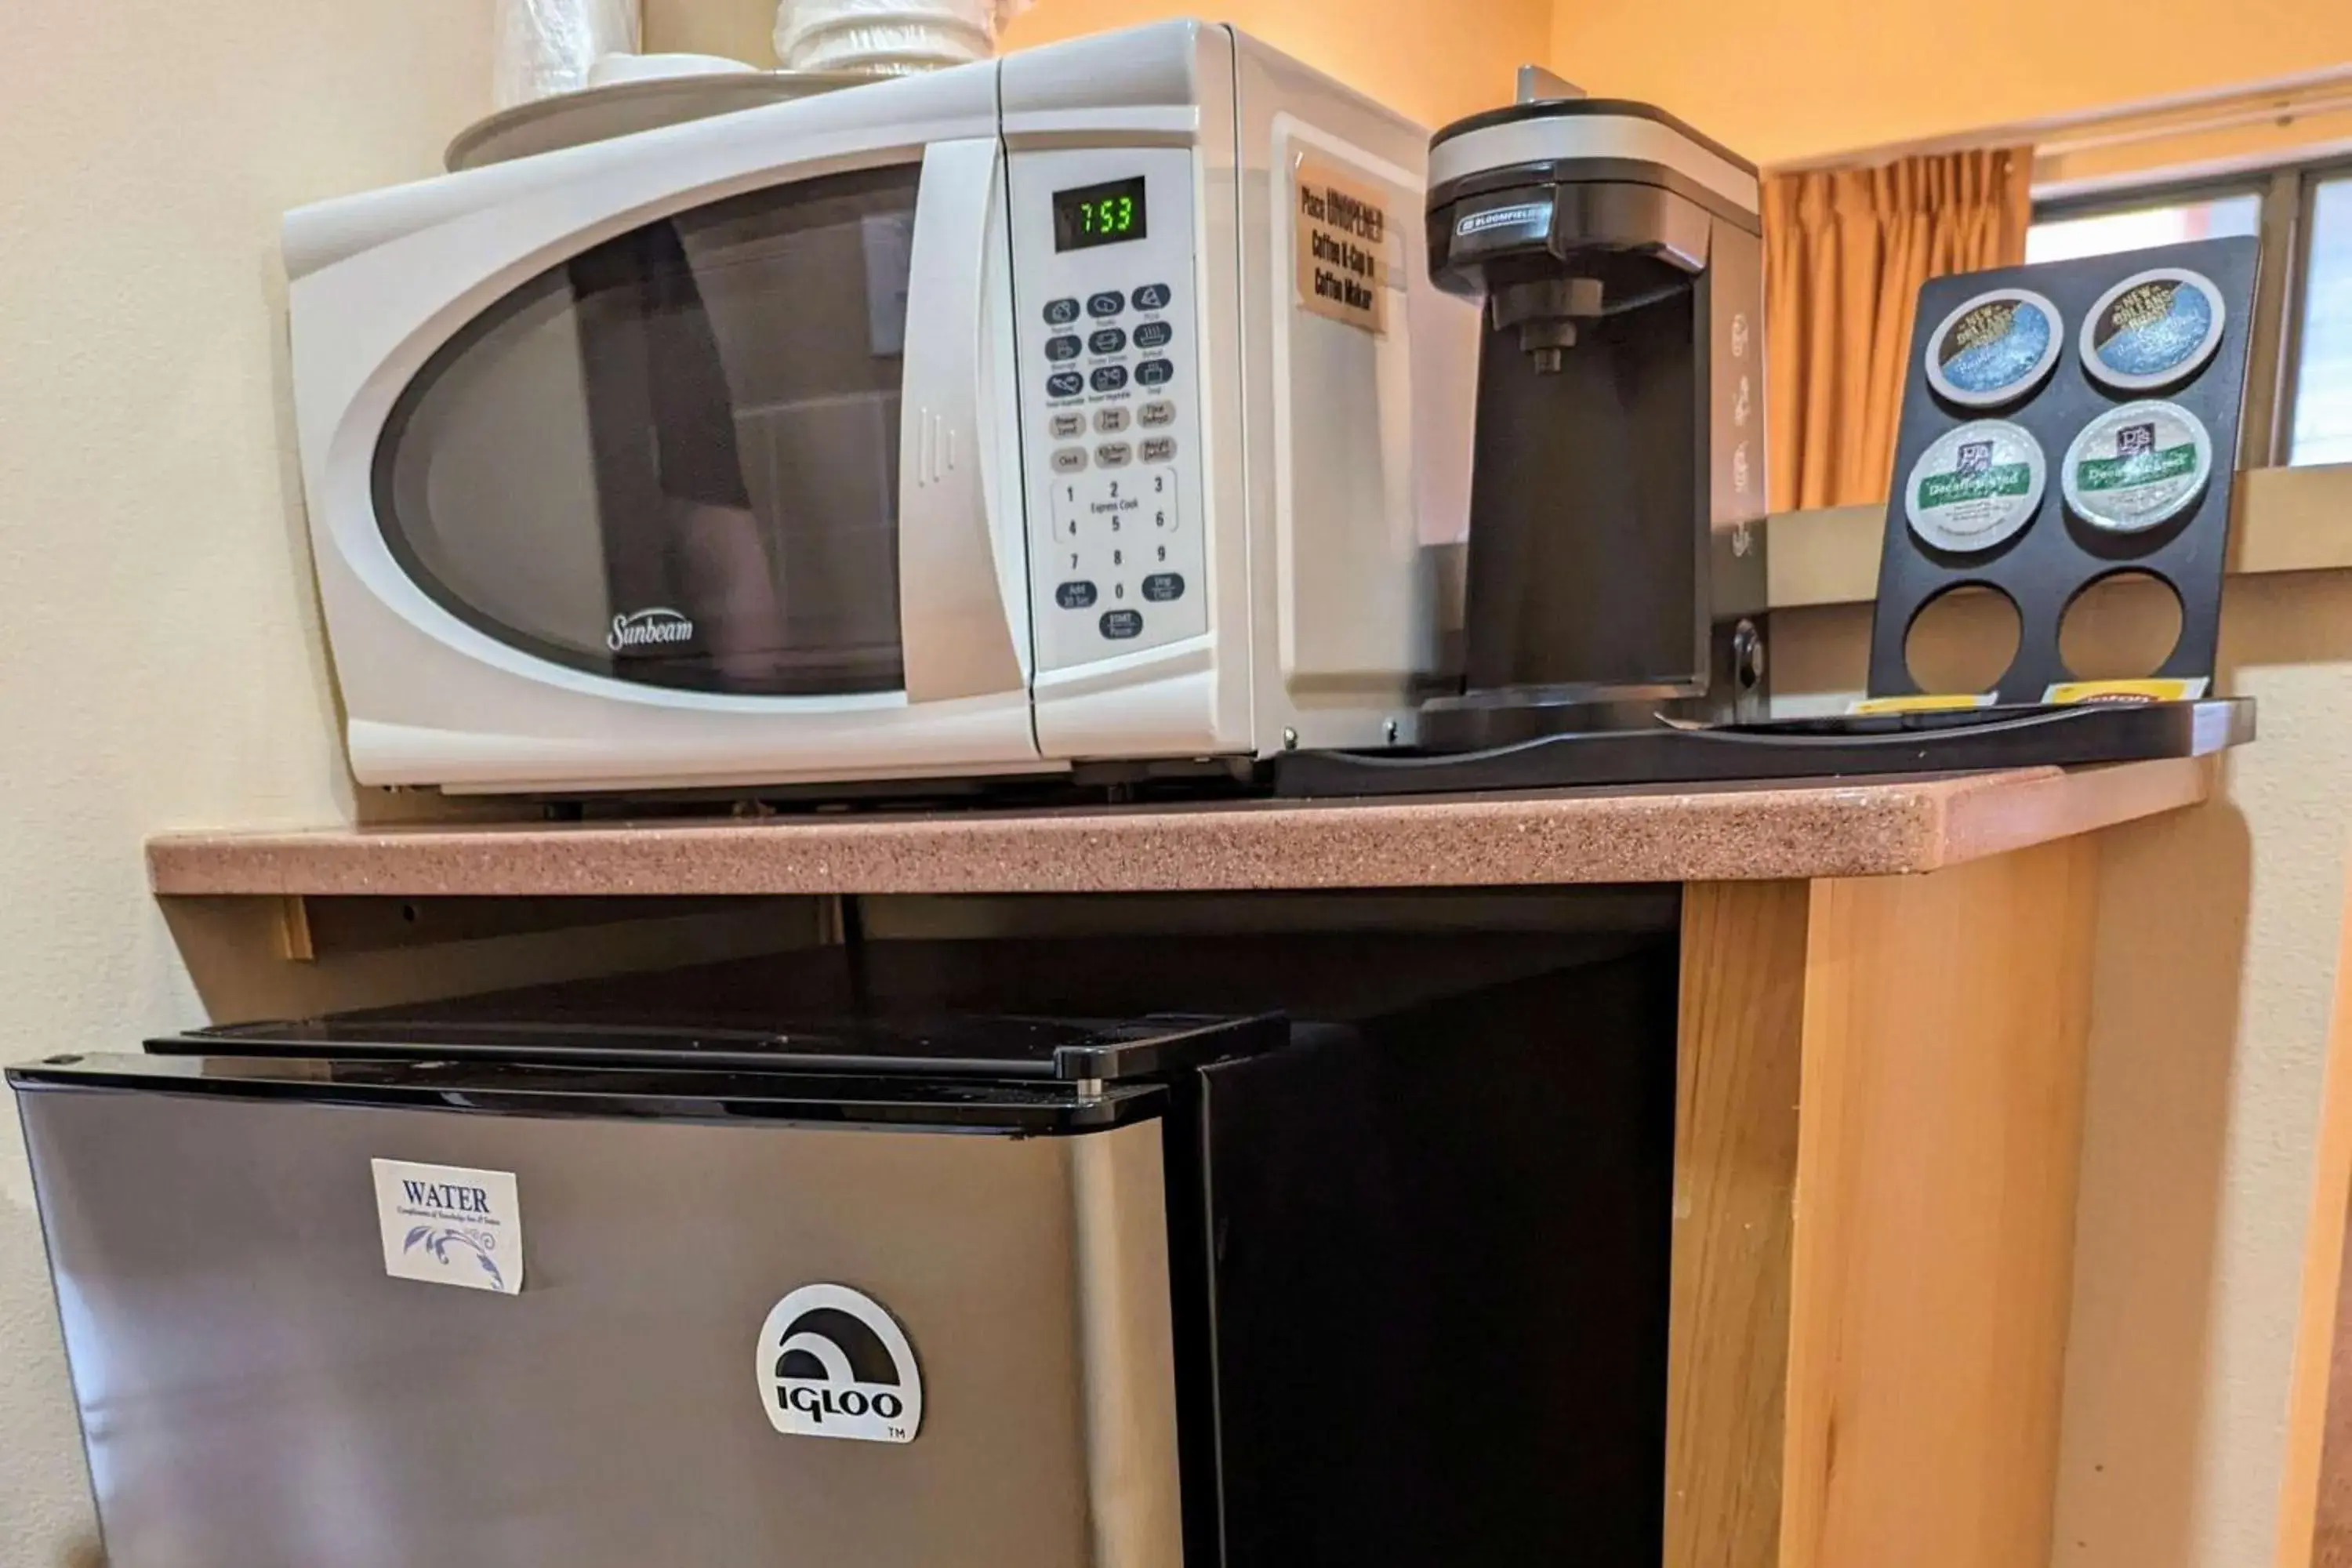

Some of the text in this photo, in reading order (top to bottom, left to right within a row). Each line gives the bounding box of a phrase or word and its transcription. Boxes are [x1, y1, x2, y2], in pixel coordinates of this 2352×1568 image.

[1312, 228, 1341, 267] Coffee
[1367, 249, 1374, 278] in
[1315, 267, 1372, 311] Coffee Maker
[1067, 476, 1163, 502] 1 2 3
[1120, 497, 1138, 510] Cook
[1069, 511, 1164, 535] 4 5 6
[1071, 545, 1166, 570] 7 8 9
[1115, 583, 1123, 599] 0
[608, 613, 693, 651] Sunbeam
[402, 1179, 490, 1213] WATER
[776, 1385, 903, 1424] IGLOO
[887, 1425, 906, 1439] TM
